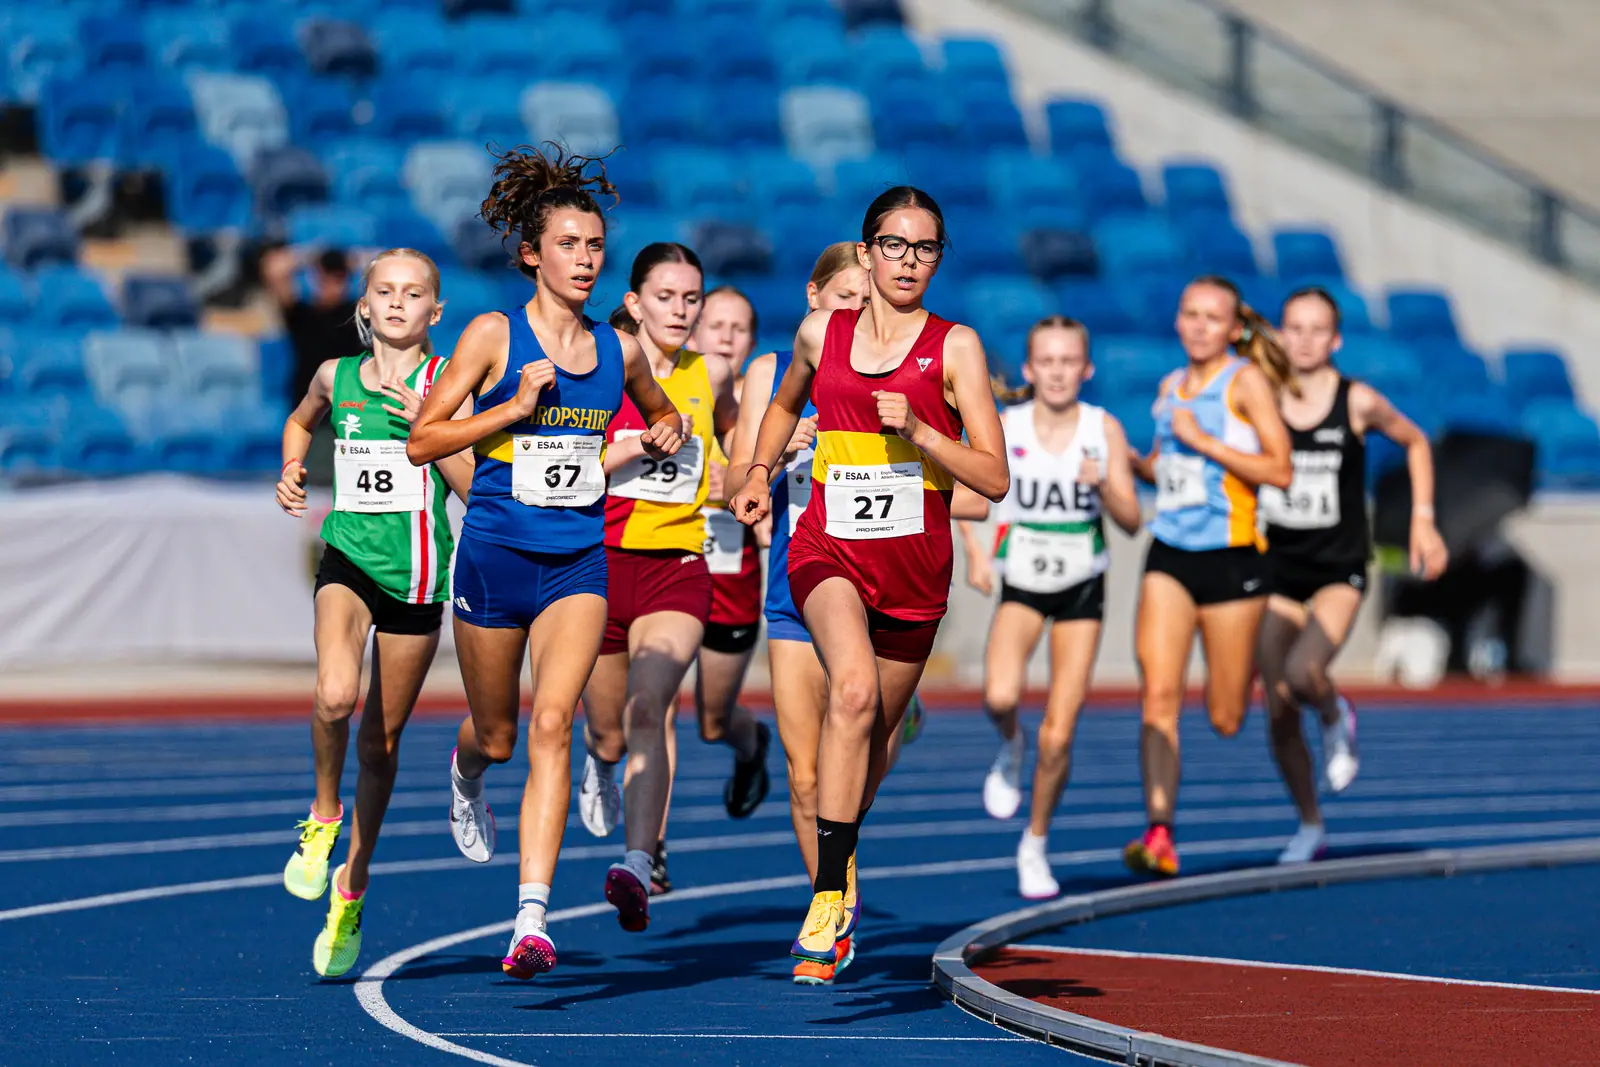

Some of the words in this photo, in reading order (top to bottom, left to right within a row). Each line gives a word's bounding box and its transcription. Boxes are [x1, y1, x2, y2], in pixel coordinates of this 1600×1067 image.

[349, 446, 371, 455] ESAA
[537, 441, 564, 450] ESAA
[356, 469, 394, 493] 48
[544, 464, 581, 489] 67
[640, 458, 678, 483] 29
[845, 471, 871, 481] ESAA
[853, 494, 894, 520] 27
[1032, 553, 1066, 577] 93
